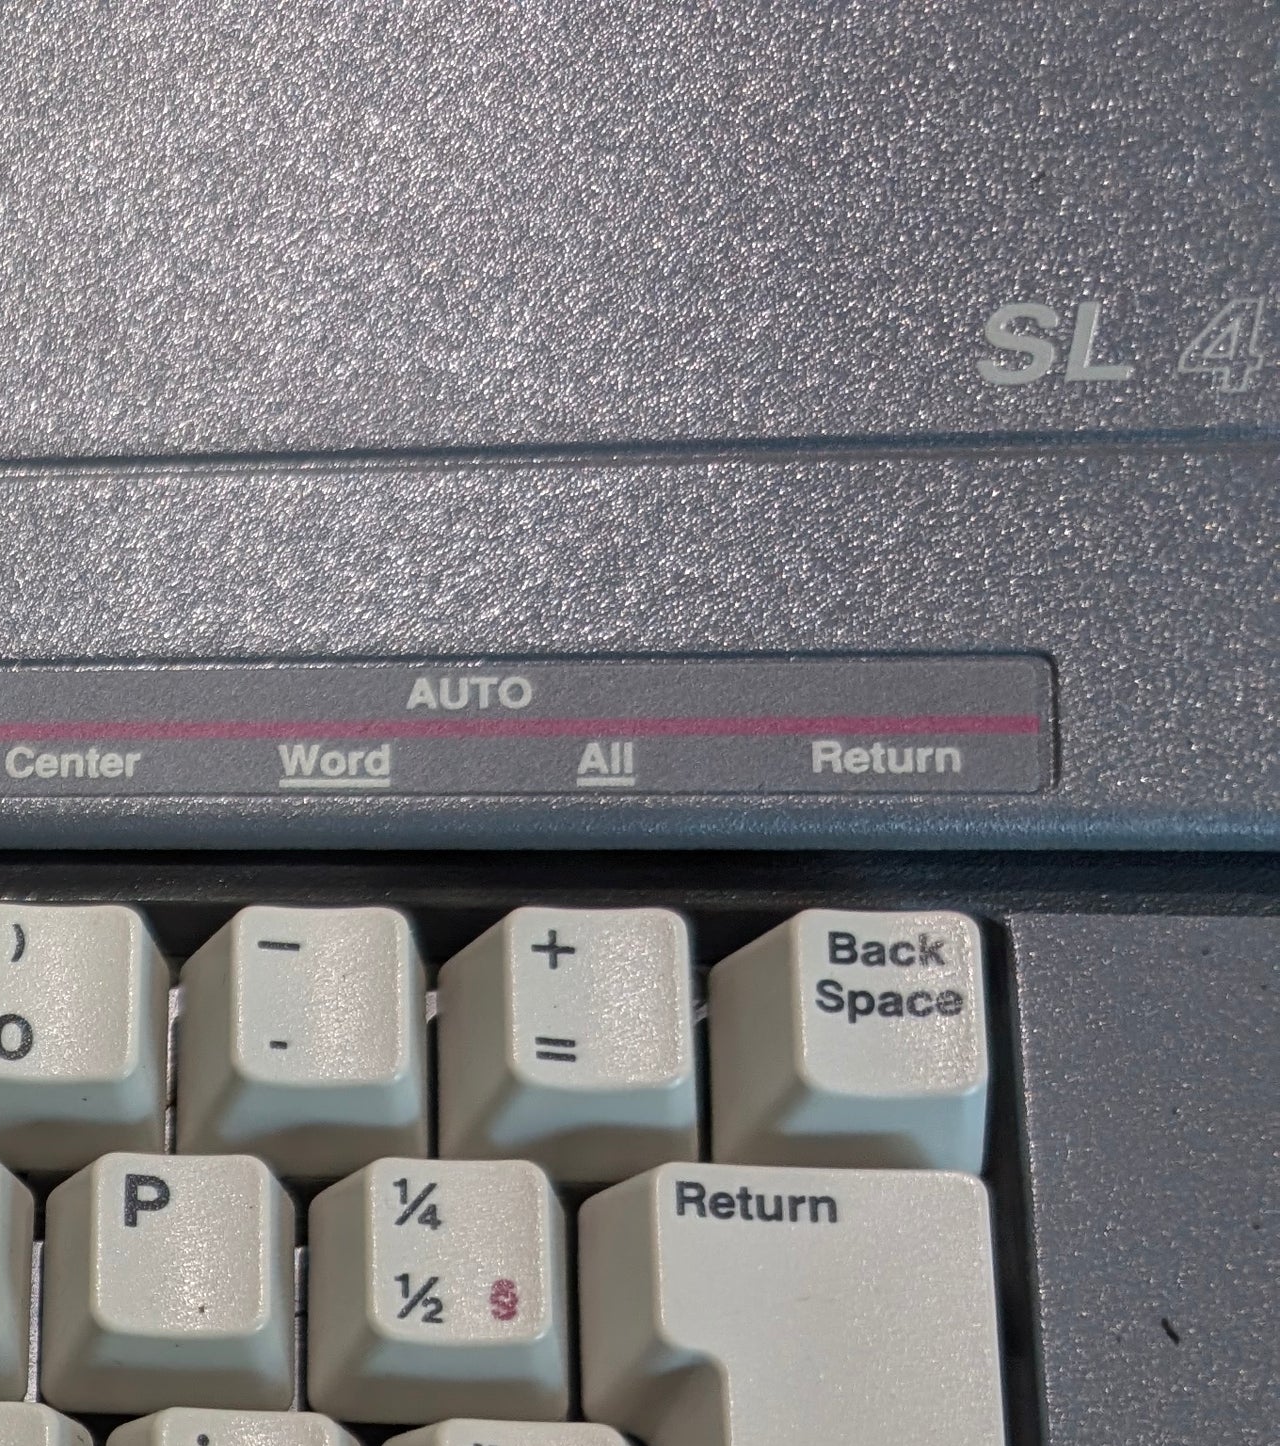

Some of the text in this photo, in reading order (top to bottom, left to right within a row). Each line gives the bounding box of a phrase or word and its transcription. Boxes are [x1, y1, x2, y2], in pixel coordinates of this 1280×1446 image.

[975, 299, 1136, 385] SL
[406, 675, 533, 710] AUTO
[5, 746, 141, 779] Center
[278, 743, 391, 777] Word
[578, 742, 635, 775] All
[811, 741, 961, 774] Return
[11, 923, 26, 963] )
[531, 929, 576, 970] +
[828, 931, 945, 967] Back
[816, 979, 964, 1024] Space
[535, 1036, 577, 1063] =
[124, 1173, 171, 1228] P
[676, 1180, 838, 1223] Return
